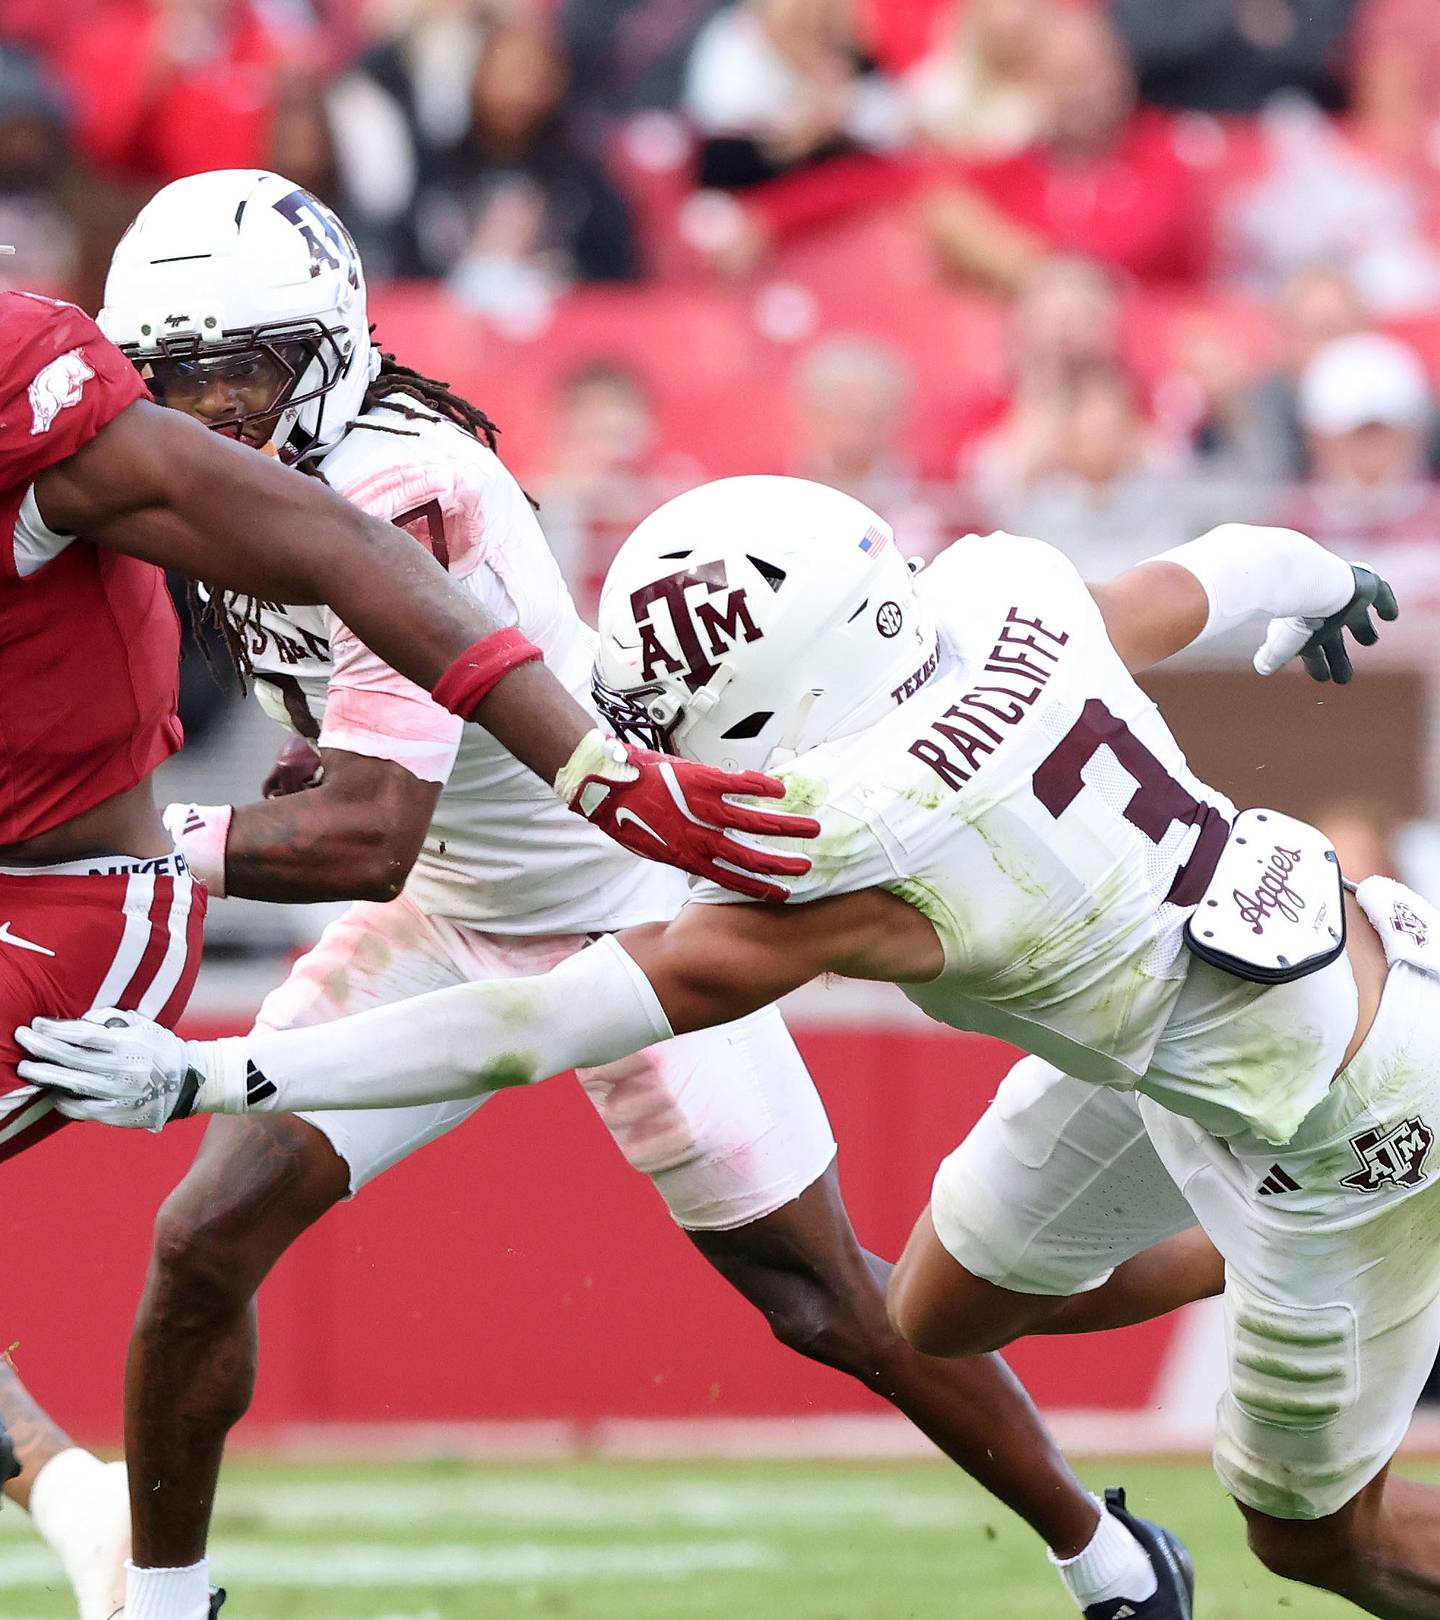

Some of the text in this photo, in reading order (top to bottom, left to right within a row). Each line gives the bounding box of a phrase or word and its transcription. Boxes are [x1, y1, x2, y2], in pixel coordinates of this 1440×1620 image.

[877, 601, 902, 638] SEC
[891, 653, 936, 706] TEXAS
[907, 606, 1070, 792] RATCLIFFE
[1032, 698, 1231, 907] 3
[1233, 845, 1306, 936] Aggies
